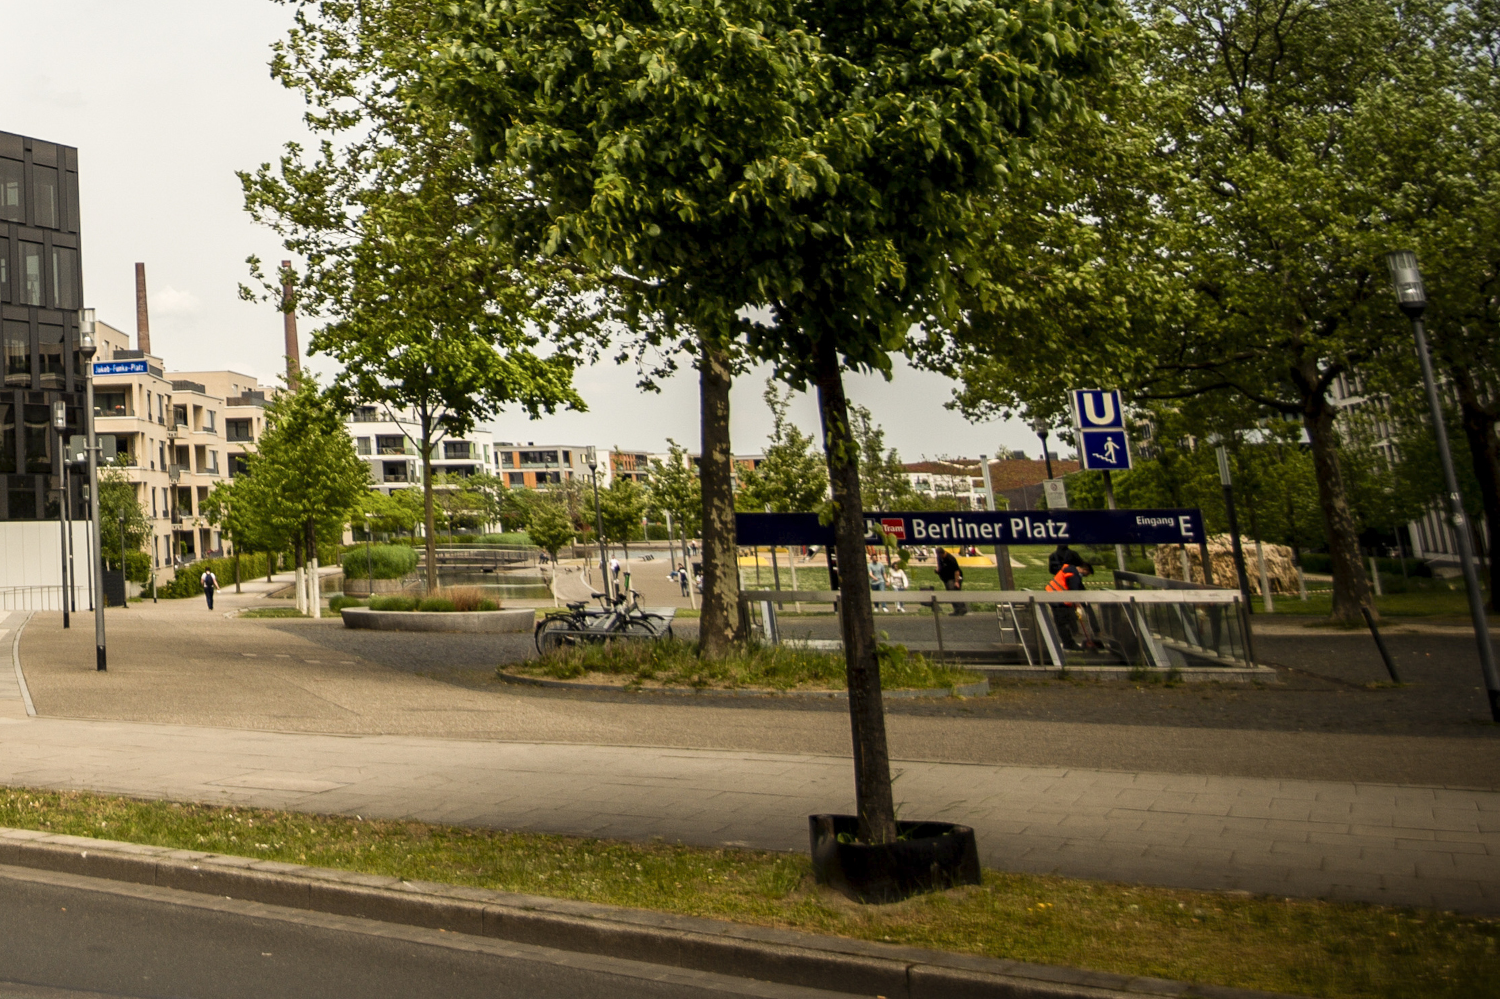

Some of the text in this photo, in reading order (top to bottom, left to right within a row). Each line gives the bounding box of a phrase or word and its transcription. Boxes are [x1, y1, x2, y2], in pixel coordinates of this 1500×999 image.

[95, 363, 144, 374] Jakob-Funke-Platz
[1082, 392, 1115, 426] U
[882, 523, 904, 533] Tram
[911, 517, 1002, 540] Berliner
[1010, 516, 1070, 539] Platz
[1136, 515, 1195, 537] Eingang E
